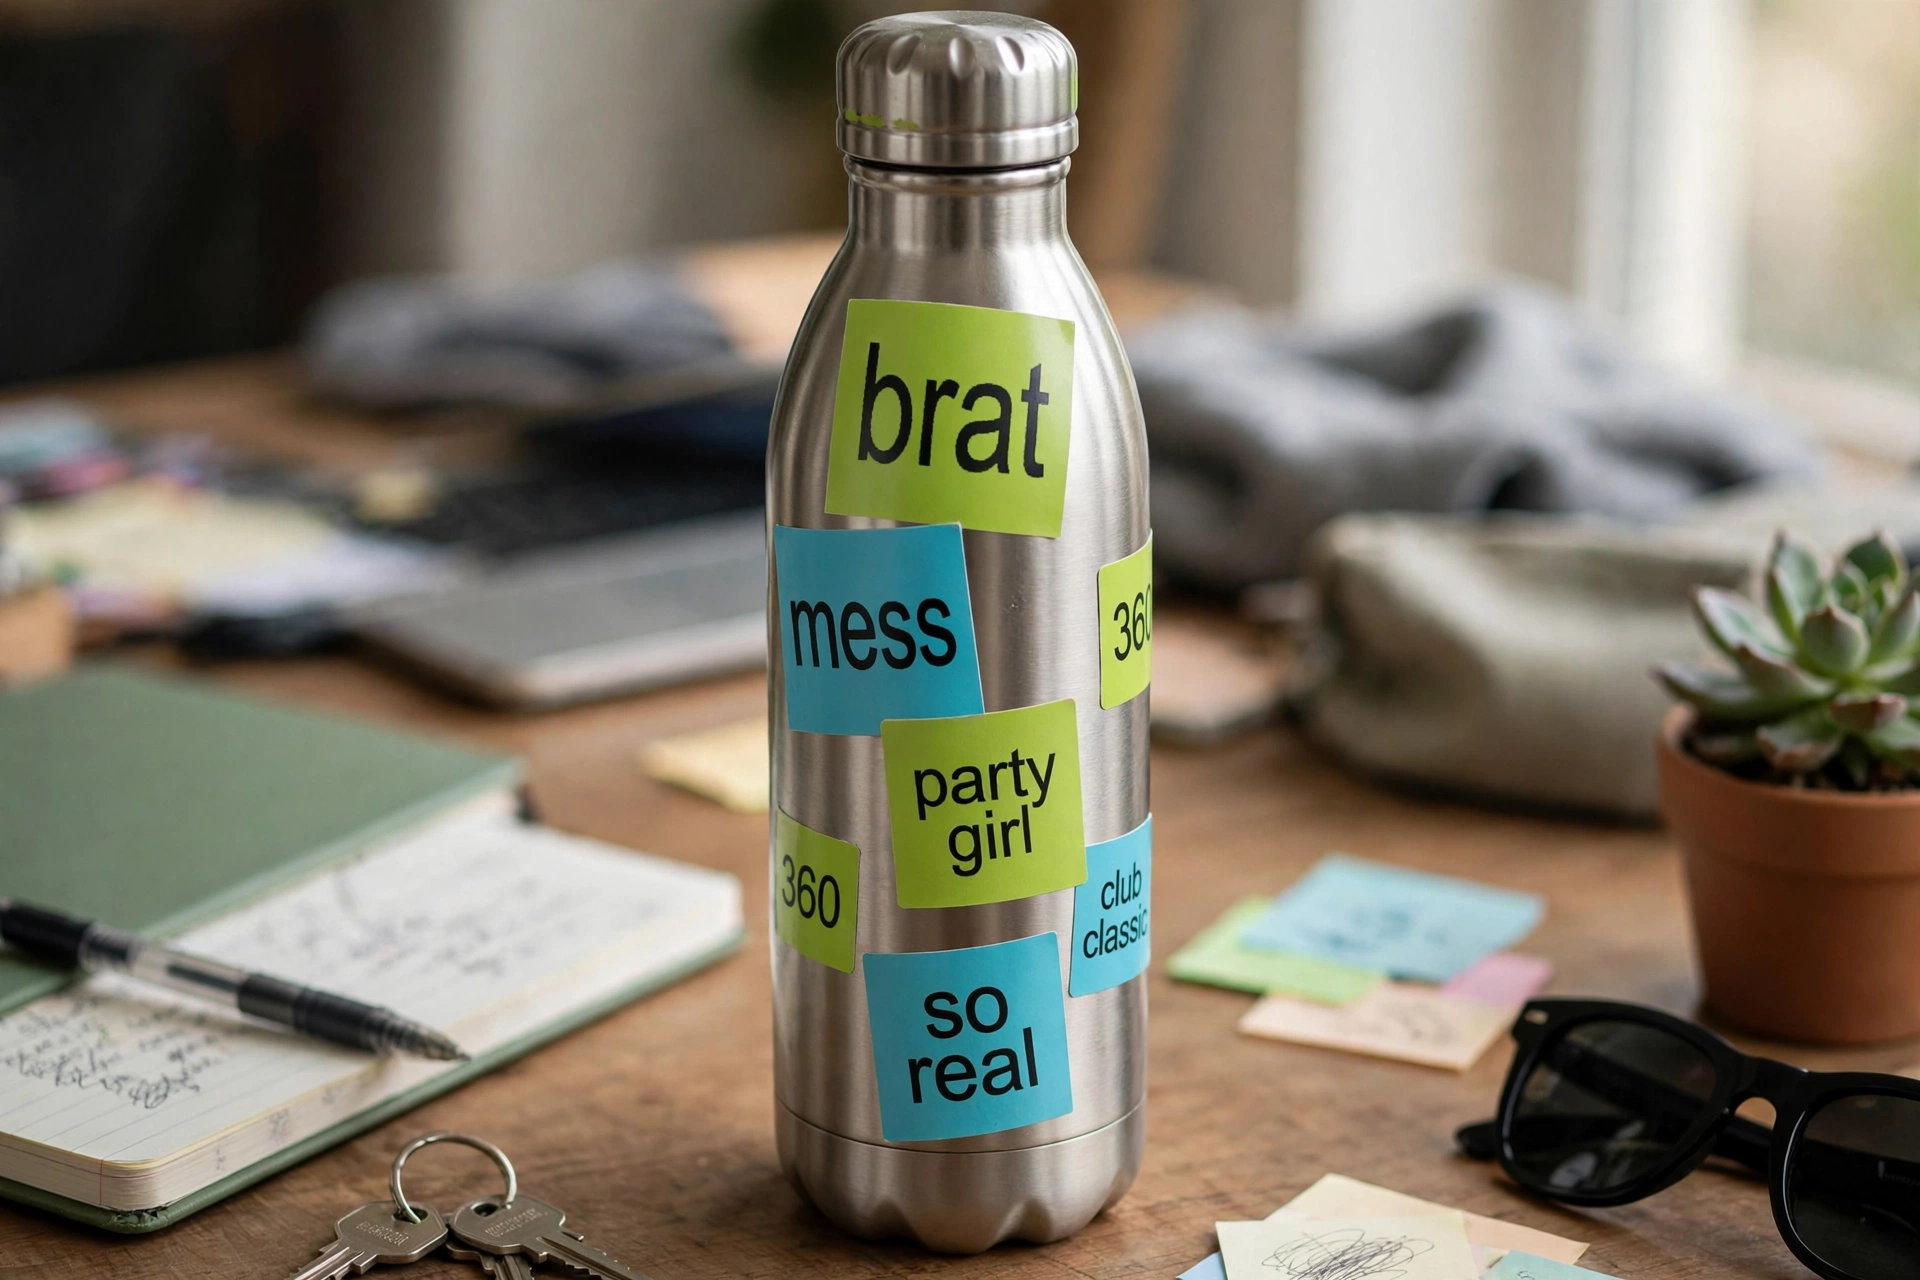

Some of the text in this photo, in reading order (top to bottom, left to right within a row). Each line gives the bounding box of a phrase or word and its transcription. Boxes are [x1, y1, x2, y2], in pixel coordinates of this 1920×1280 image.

[857, 342, 1049, 479] brat
[790, 598, 957, 671] mess
[1113, 583, 1152, 662] 360
[913, 748, 1056, 821] party
[948, 804, 1032, 878] girl
[782, 854, 841, 929] 360
[1101, 861, 1142, 910] club
[923, 986, 1009, 1040] so
[907, 1026, 1039, 1104] real
